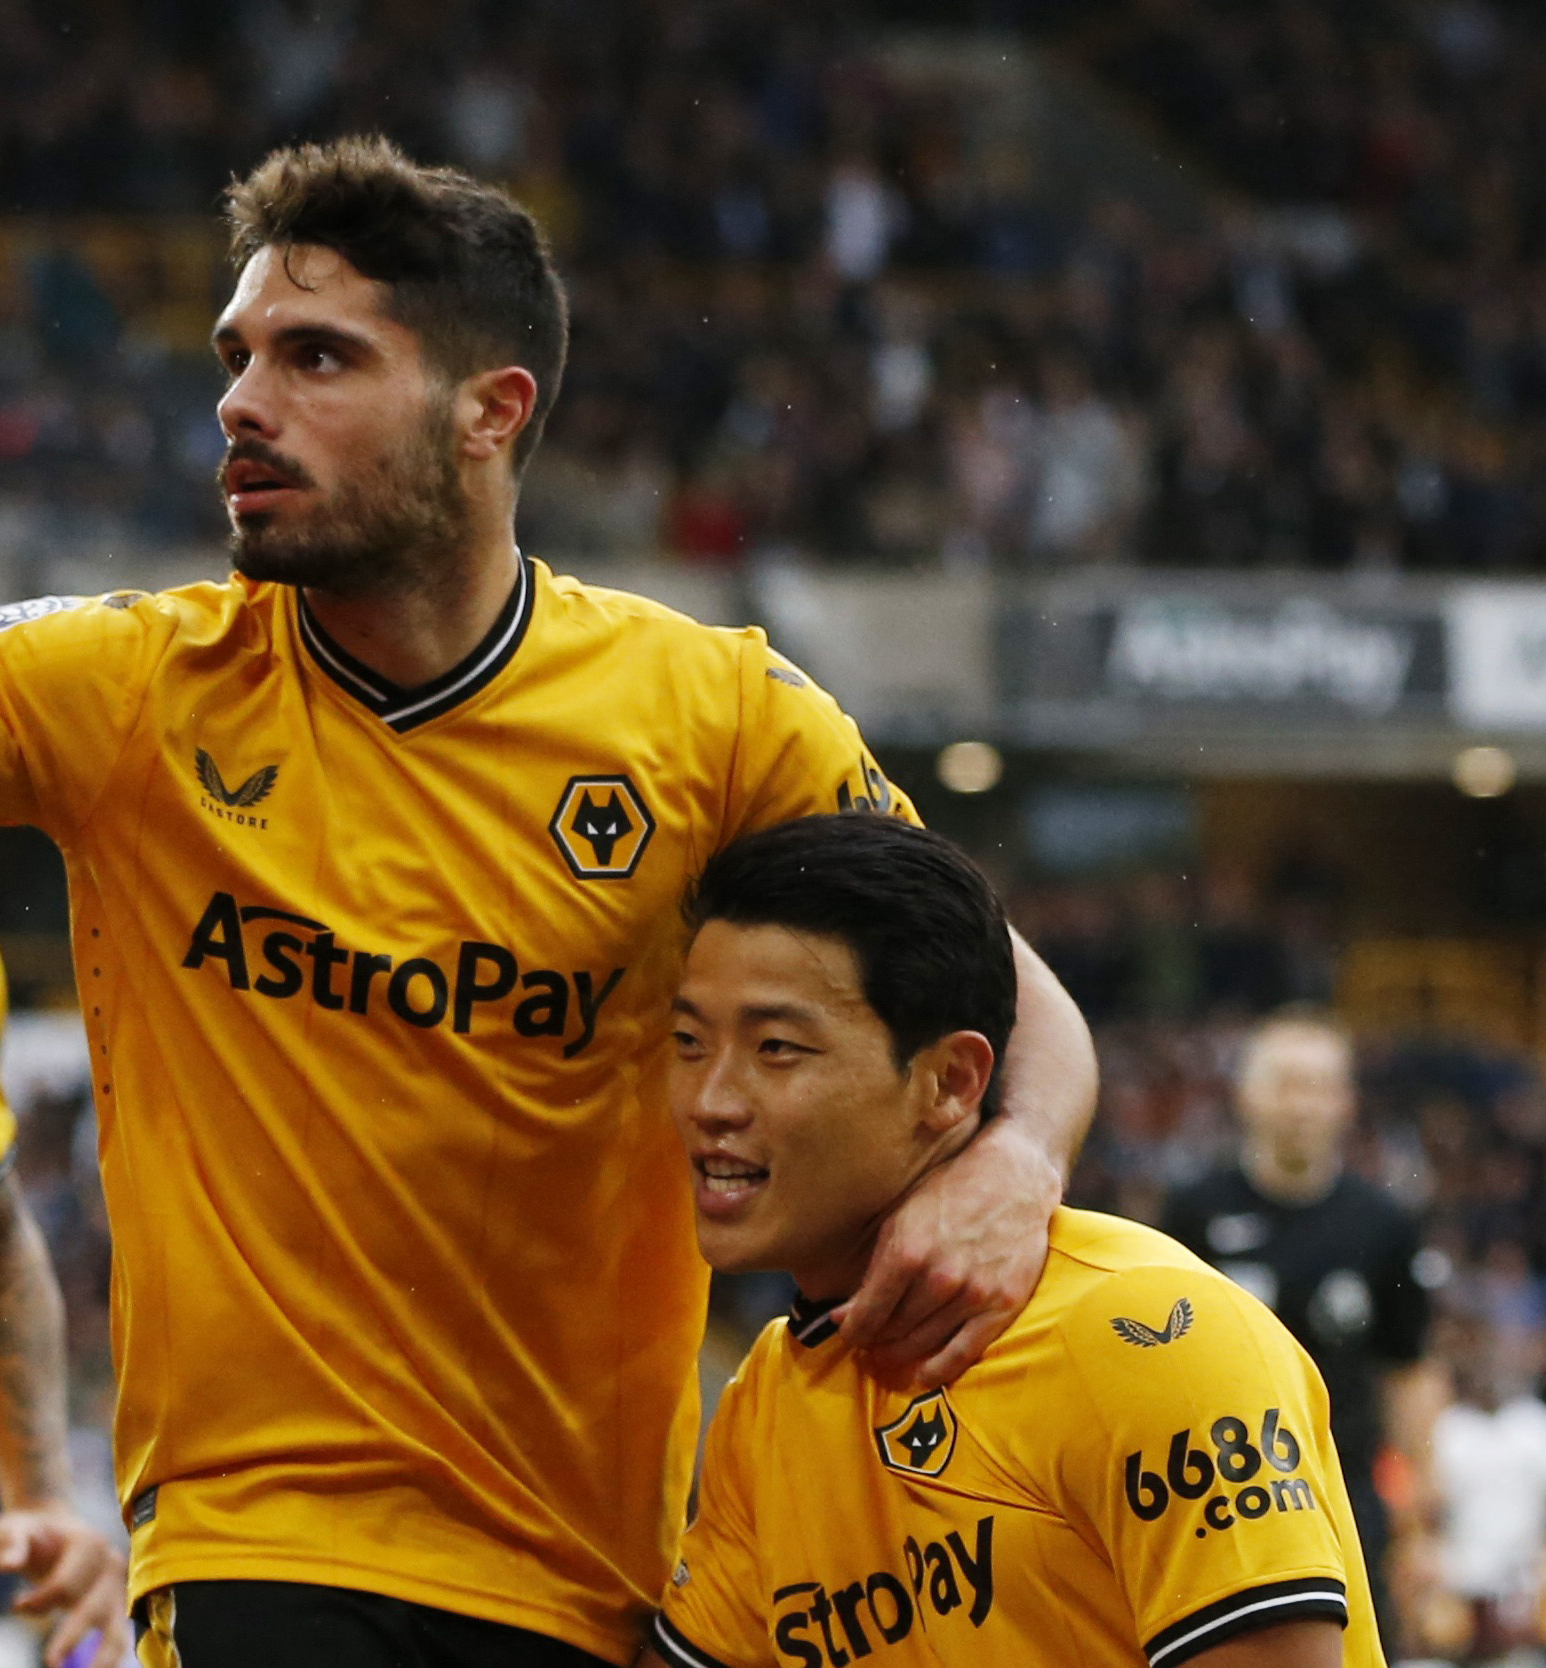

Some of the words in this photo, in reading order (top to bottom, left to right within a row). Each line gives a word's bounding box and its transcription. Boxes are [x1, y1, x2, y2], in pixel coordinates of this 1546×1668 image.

[181, 892, 626, 1058] AstroPay
[1124, 1408, 1301, 1521] 6686
[1195, 1478, 1316, 1539] .com
